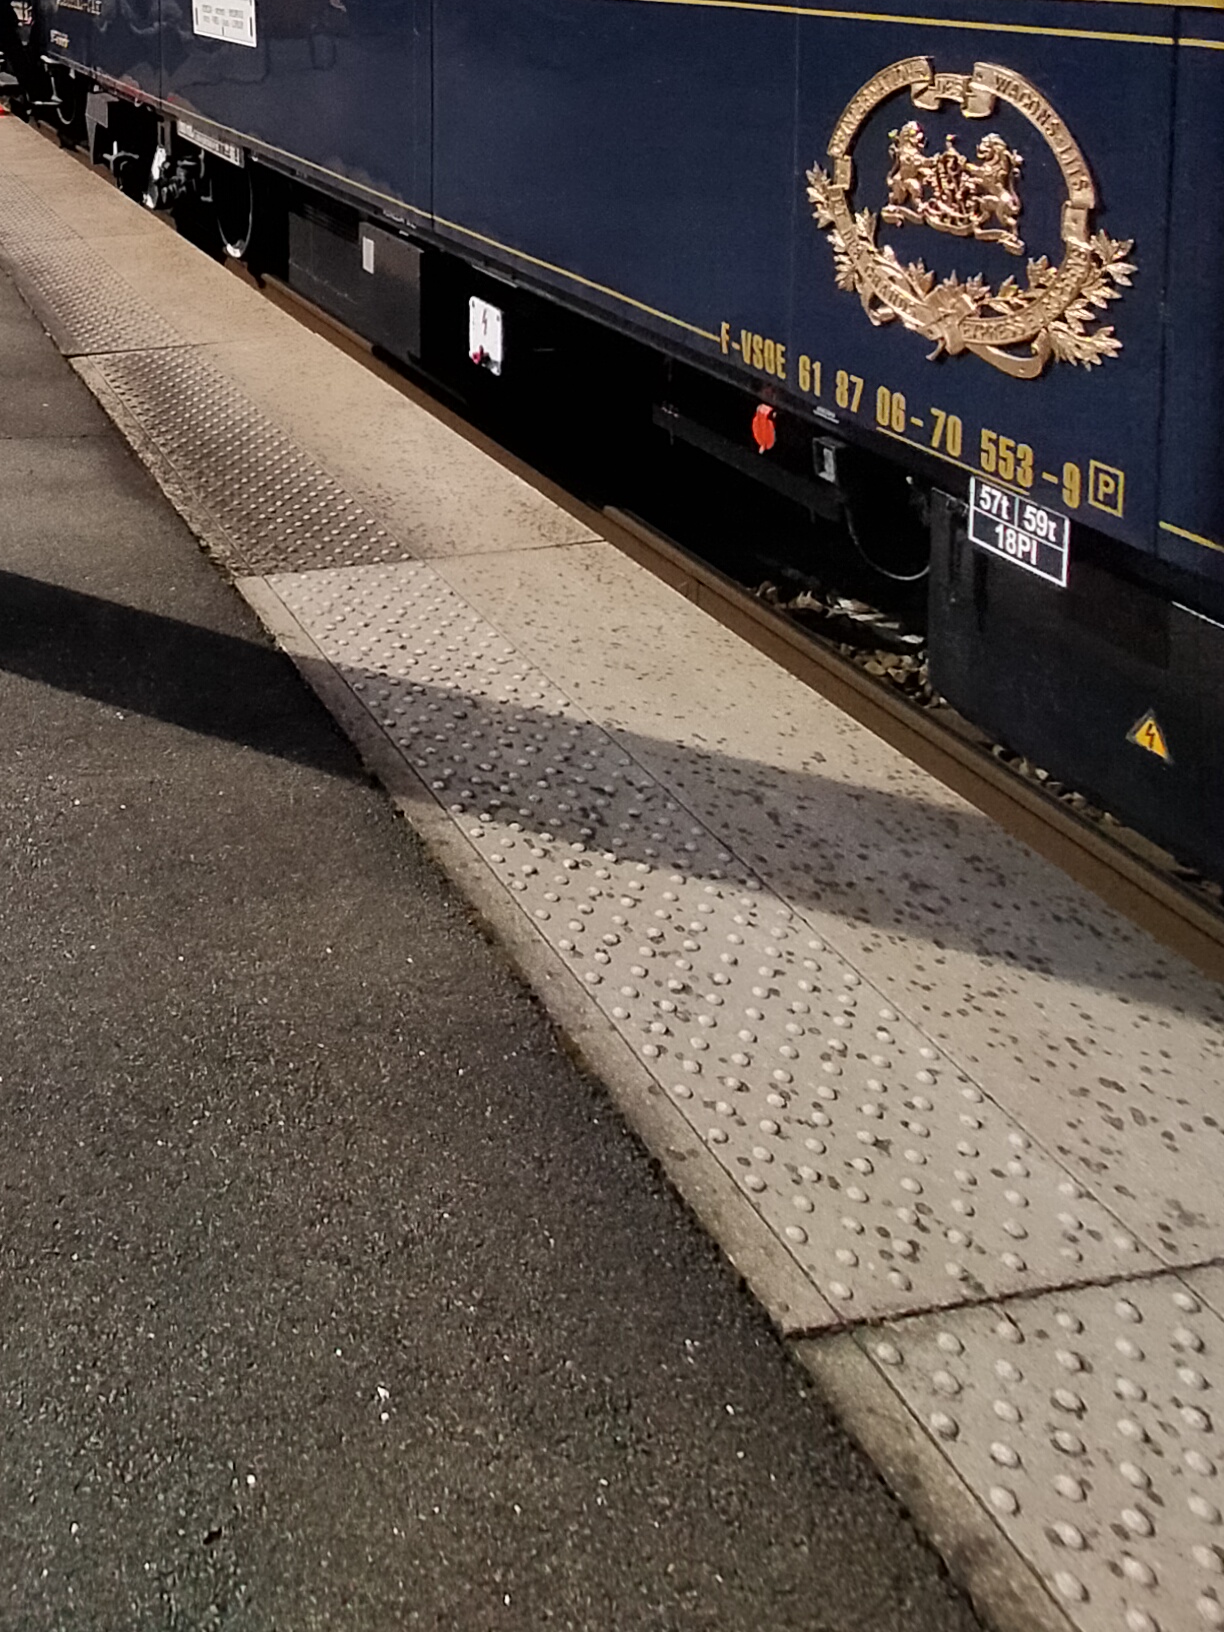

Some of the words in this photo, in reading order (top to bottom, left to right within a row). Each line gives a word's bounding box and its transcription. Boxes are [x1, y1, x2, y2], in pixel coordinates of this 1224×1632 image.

[721, 321, 787, 380] F-VSOE
[798, 355, 821, 397] 61
[836, 370, 864, 413] 87
[1097, 473, 1116, 501] P
[979, 485, 1010, 521] 57t
